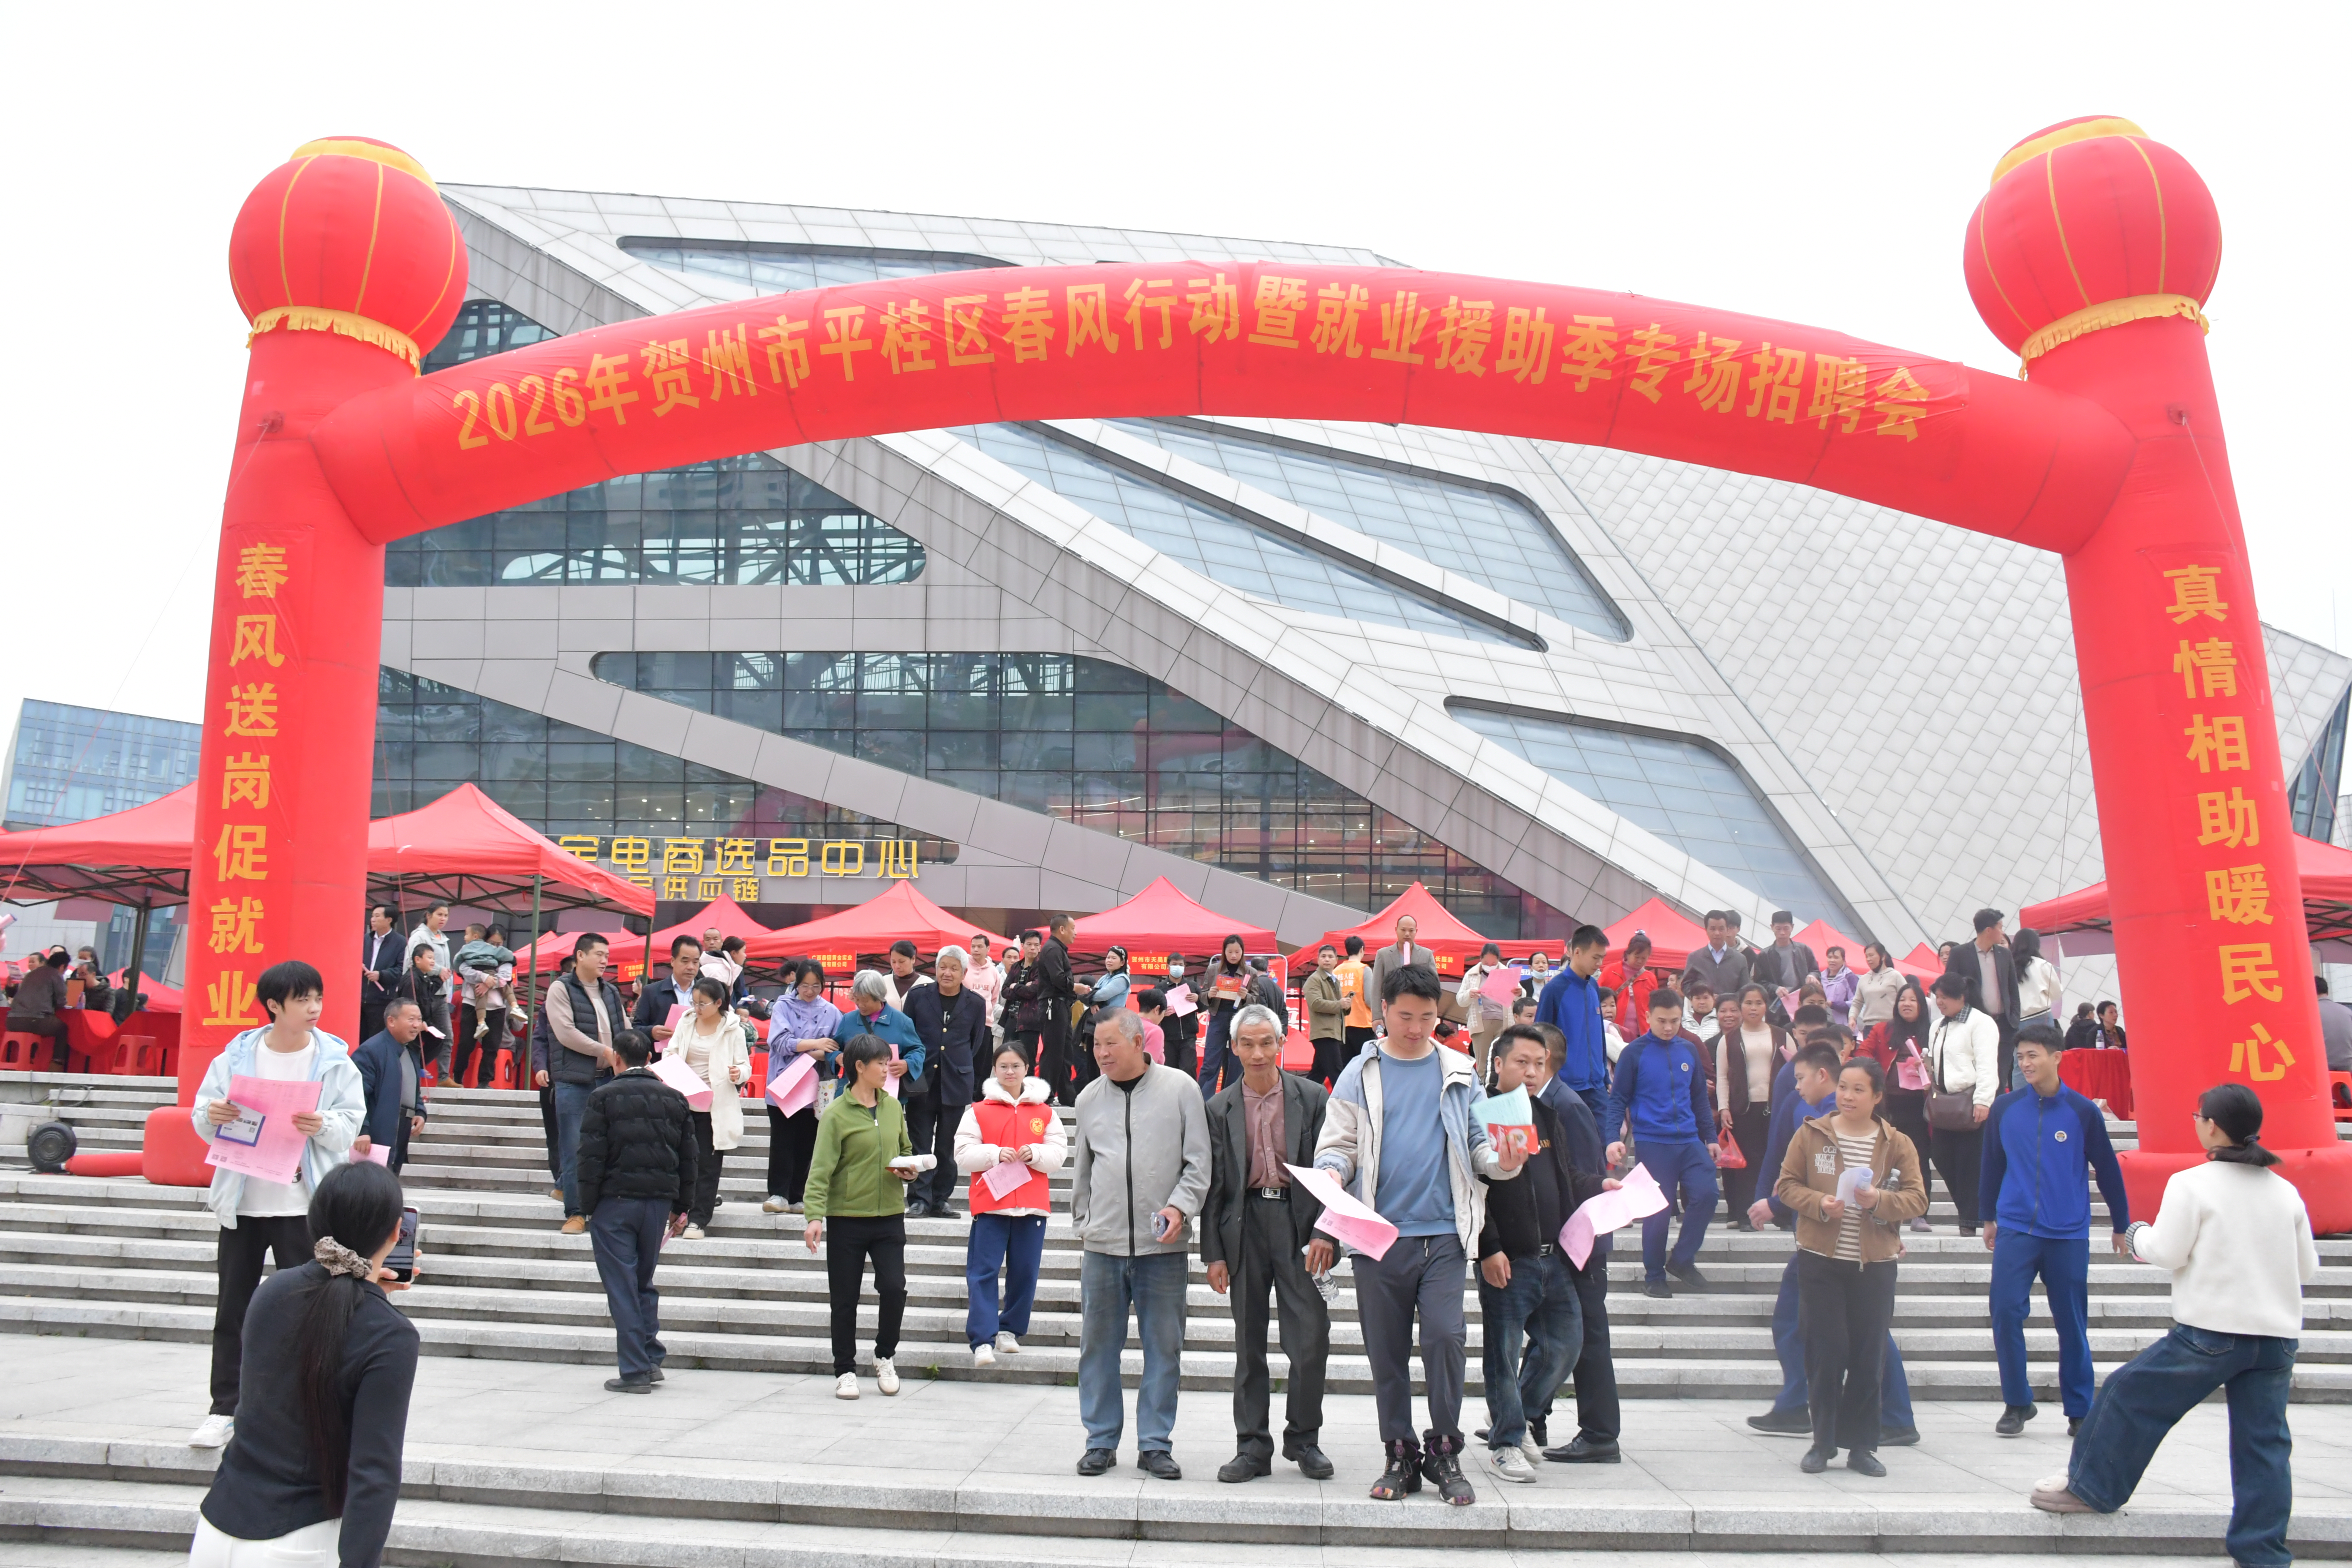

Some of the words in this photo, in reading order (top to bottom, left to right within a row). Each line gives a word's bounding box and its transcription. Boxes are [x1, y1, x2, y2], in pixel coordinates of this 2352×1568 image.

[453, 272, 1930, 451] 2026年贺州市平桂区春风行动暨就业援助季专场招聘会
[203, 543, 288, 1026] 春风送岗促就业
[2164, 565, 2295, 1082] 真情相助暖民心
[972, 983, 989, 991] PLEASE
